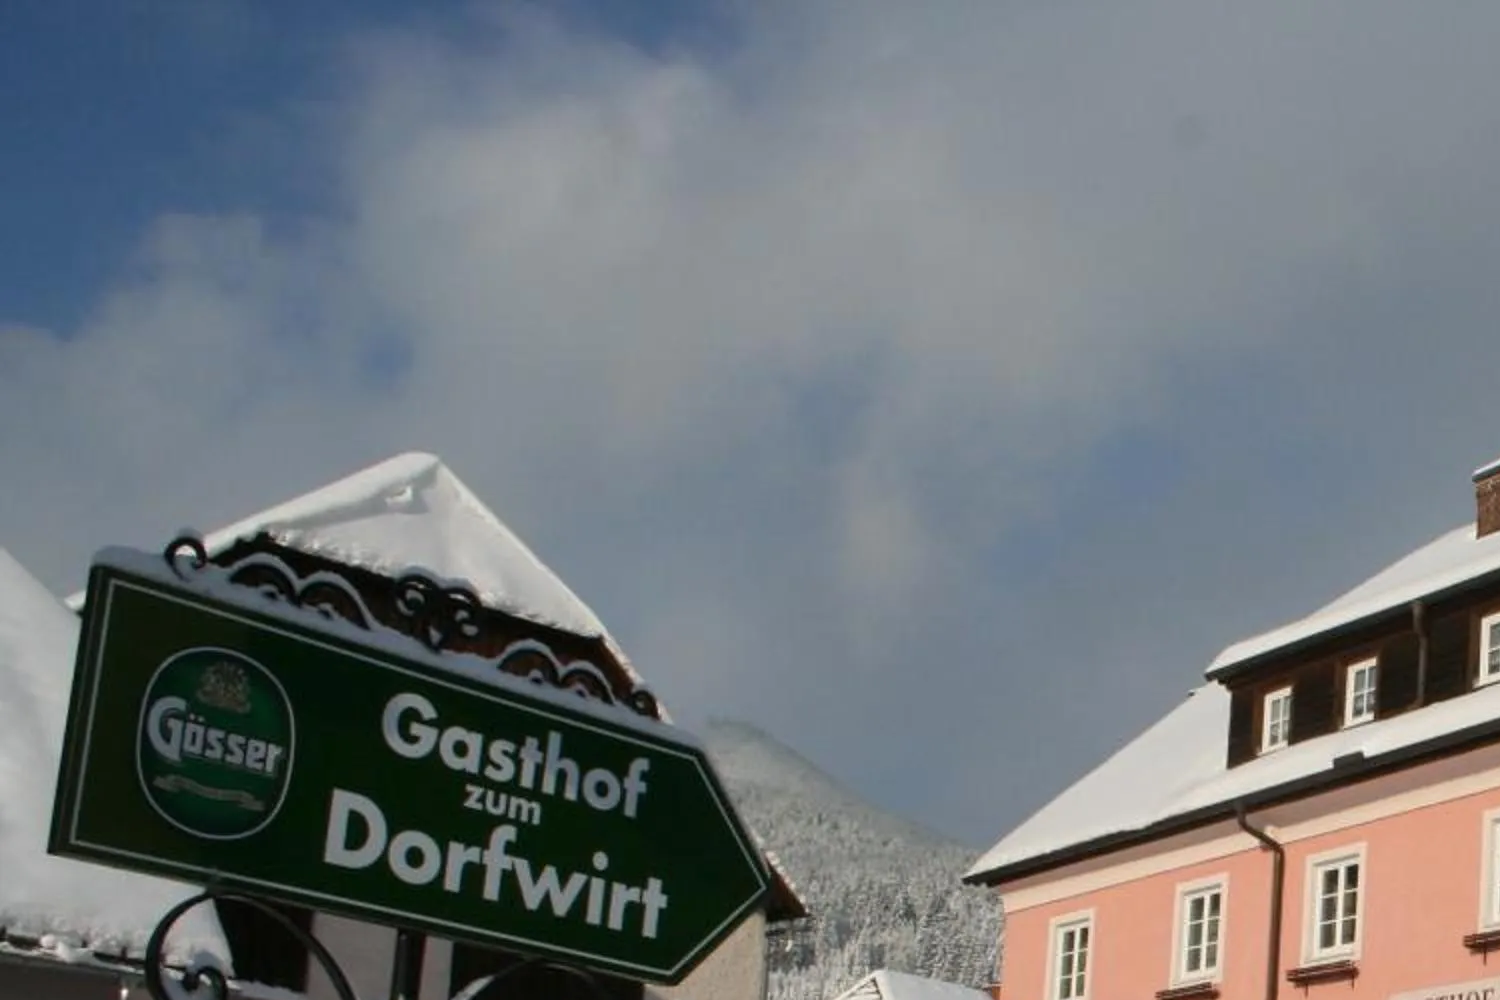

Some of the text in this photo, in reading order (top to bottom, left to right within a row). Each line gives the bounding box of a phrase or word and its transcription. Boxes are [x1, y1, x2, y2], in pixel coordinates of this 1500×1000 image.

[147, 696, 283, 774] Gösser
[381, 692, 649, 818] Gasthof
[463, 784, 541, 825] zum
[324, 788, 667, 938] Dorfwirt
